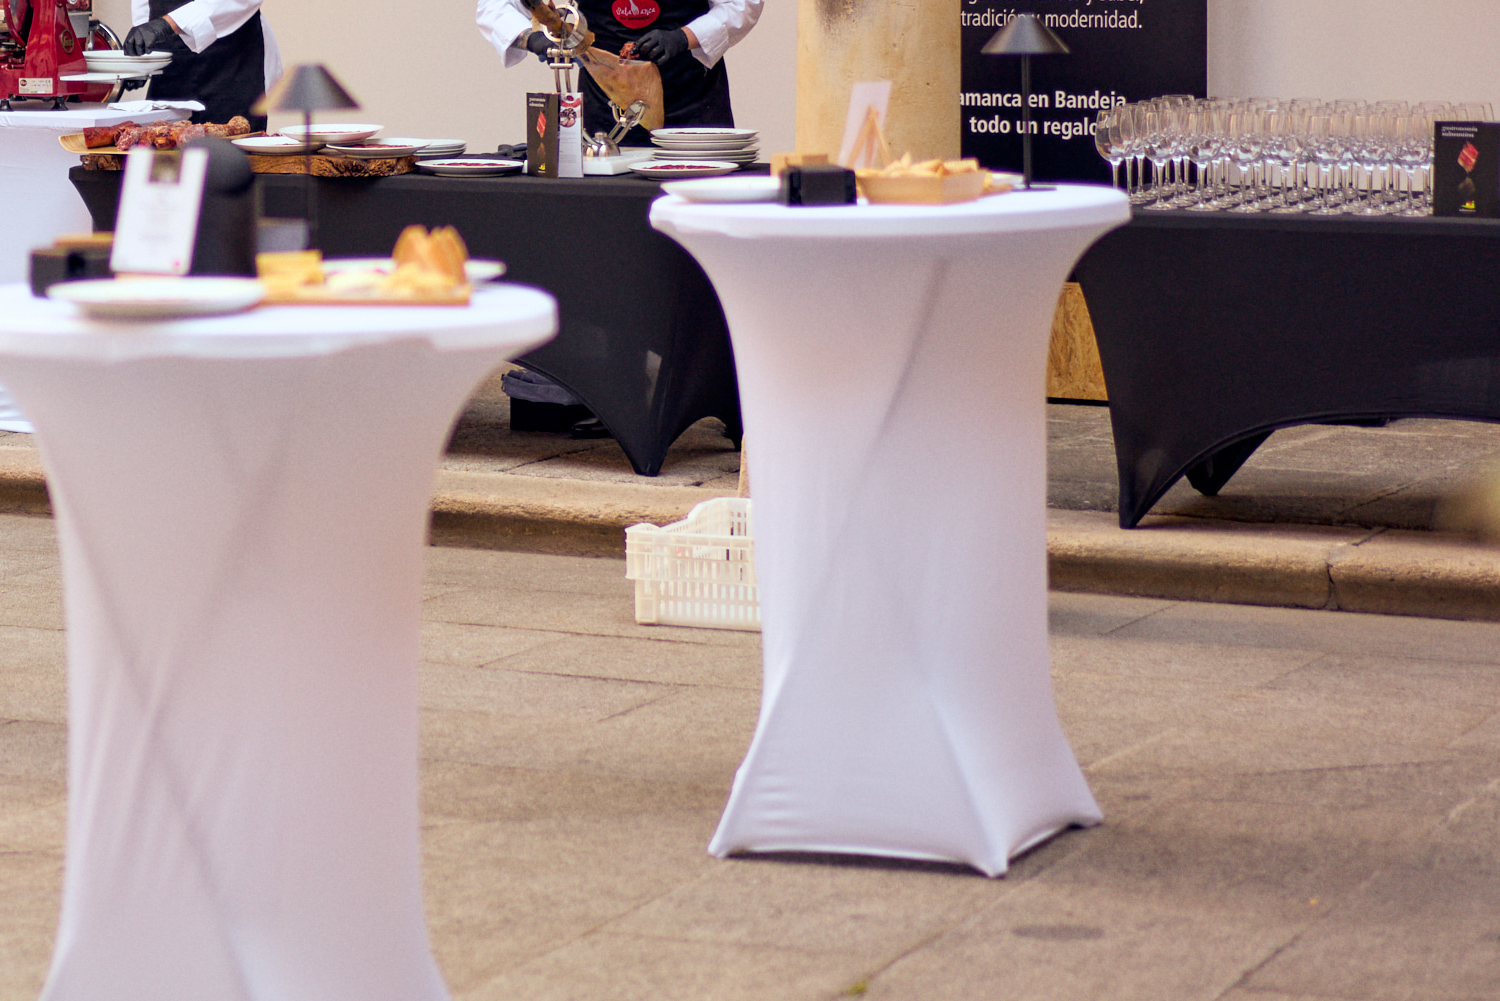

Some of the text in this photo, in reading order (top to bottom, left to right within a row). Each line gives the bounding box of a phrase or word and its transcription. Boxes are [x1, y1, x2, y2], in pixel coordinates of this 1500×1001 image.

[960, 8, 1143, 29] tradició modernidad.
[960, 92, 1022, 107] amanca
[1028, 94, 1049, 108] en
[969, 115, 1011, 134] todo
[1016, 120, 1038, 135] un
